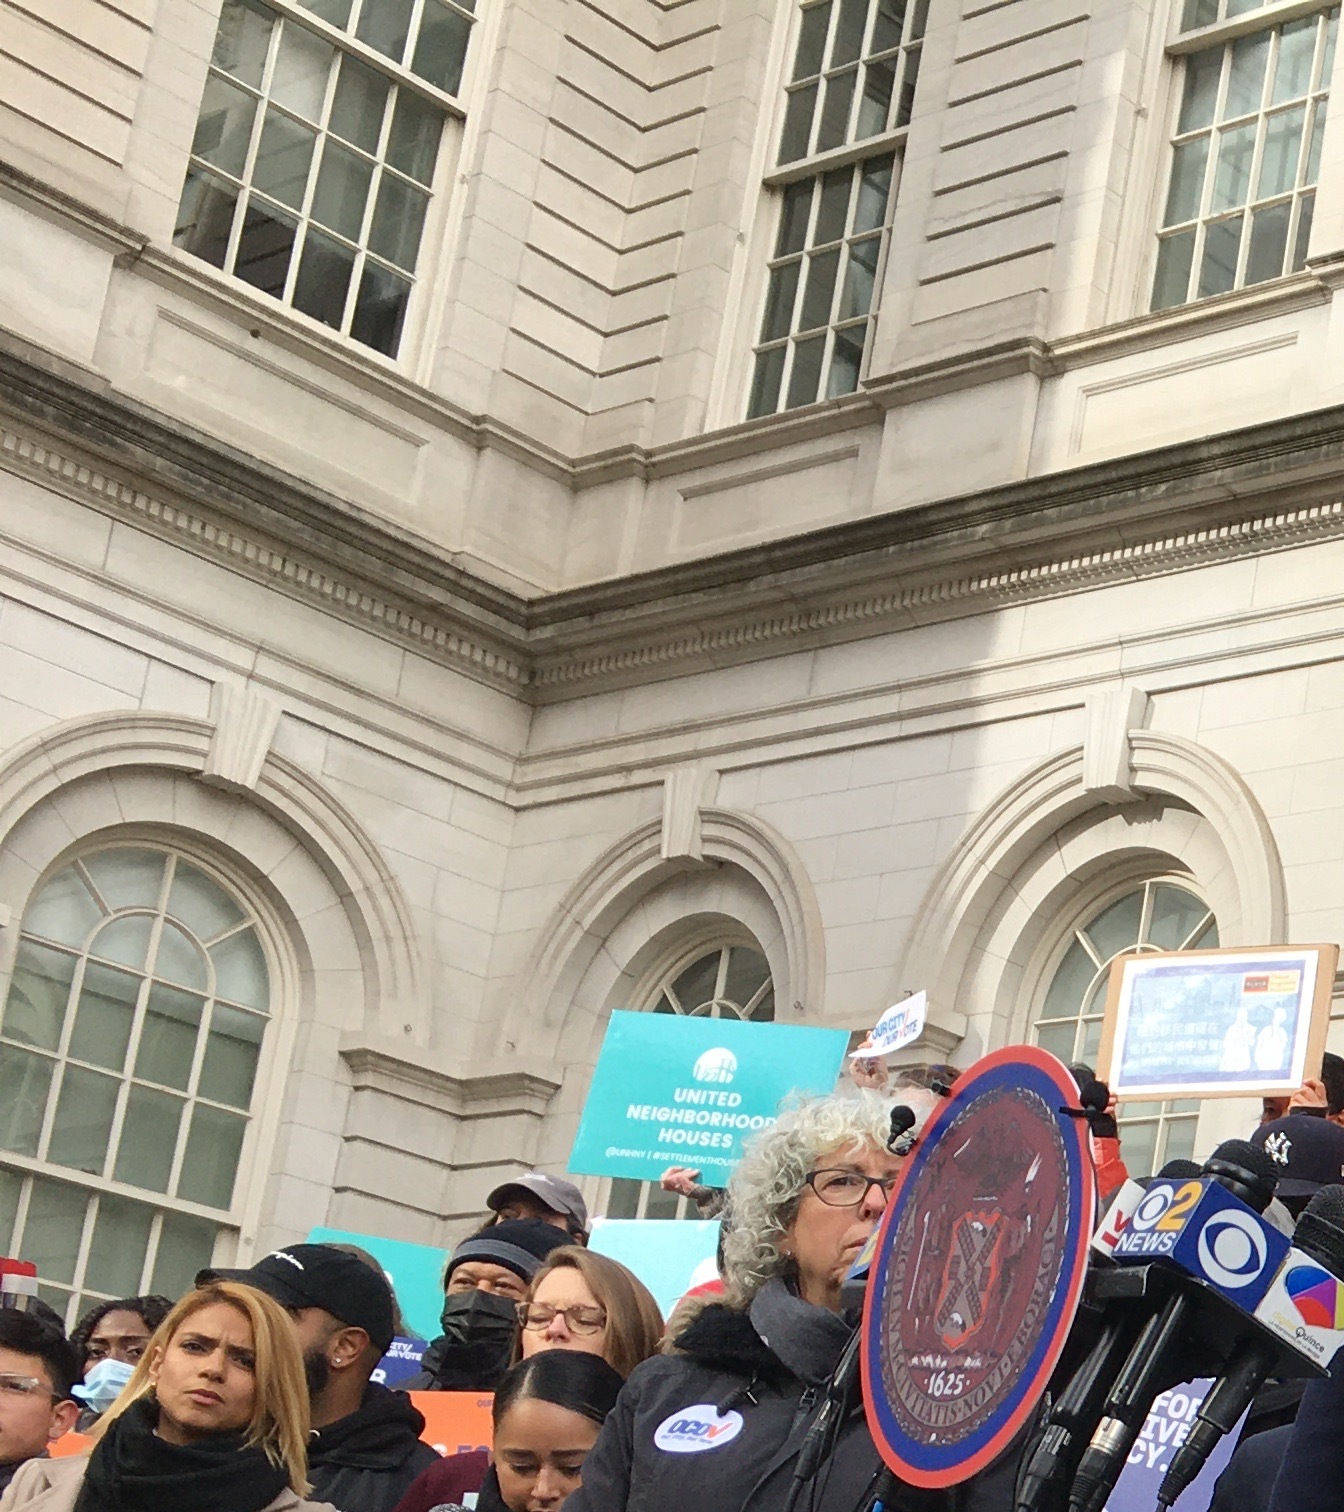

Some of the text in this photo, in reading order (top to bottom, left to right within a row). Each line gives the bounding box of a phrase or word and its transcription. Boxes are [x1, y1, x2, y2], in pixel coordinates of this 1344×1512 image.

[674, 1087, 742, 1107] UNITED
[626, 1104, 778, 1130] NEIGHBORHOOD
[658, 1127, 734, 1148] HOUSES
[1155, 1181, 1203, 1230] 2
[1114, 1232, 1177, 1252] NEWS
[1295, 1325, 1325, 1354] Quince
[927, 1370, 965, 1397] 1625
